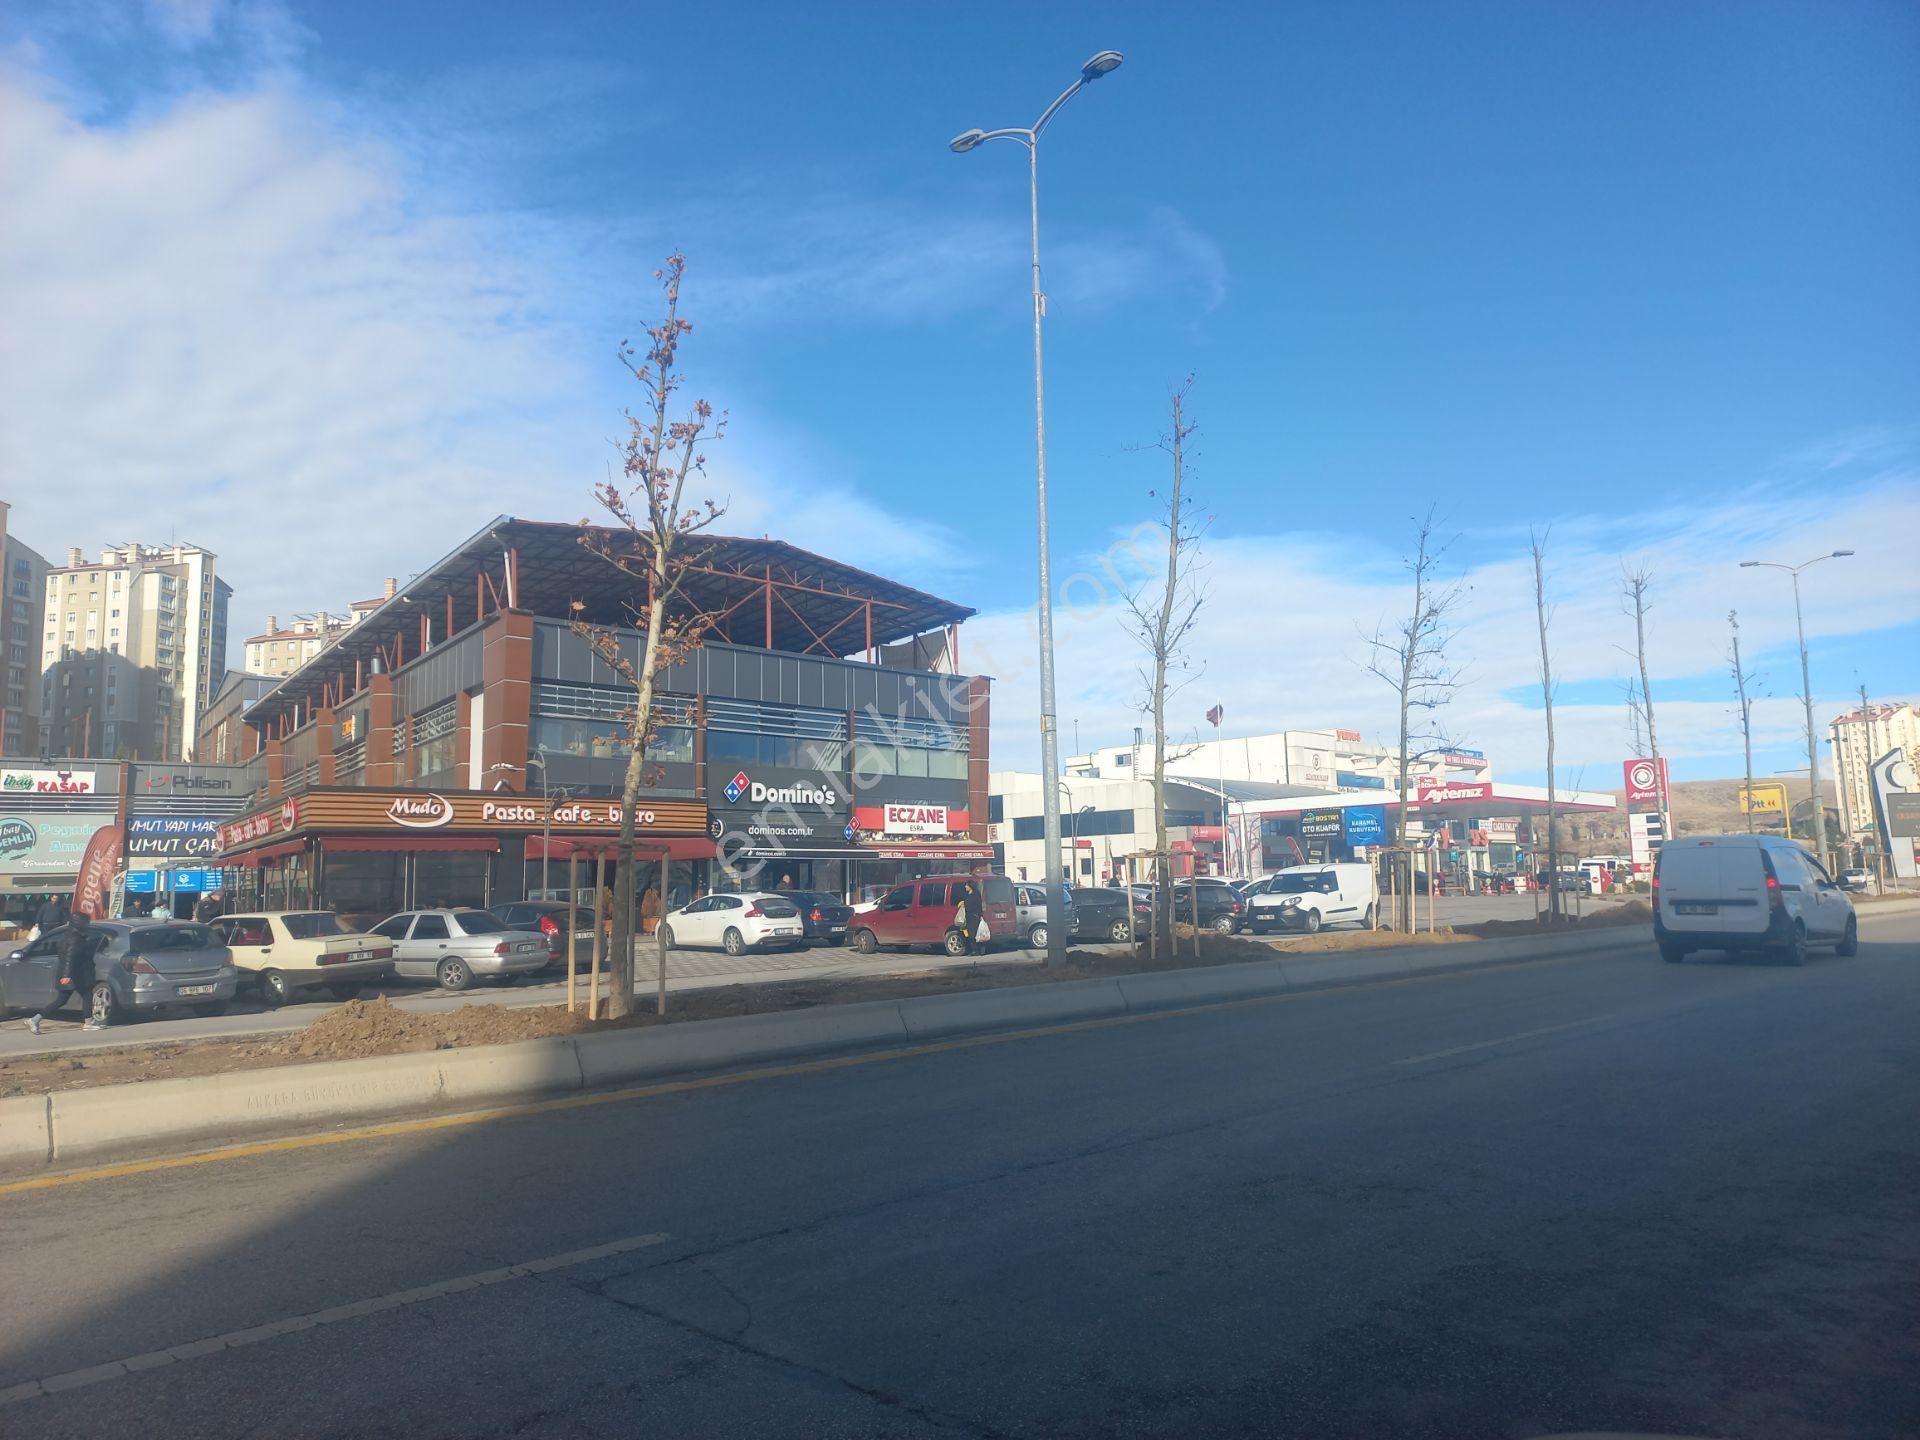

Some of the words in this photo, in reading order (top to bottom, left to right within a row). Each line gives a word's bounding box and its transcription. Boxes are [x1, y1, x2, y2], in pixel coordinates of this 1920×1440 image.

[38, 781, 89, 793] KASAP
[172, 775, 232, 790] Polisan
[751, 782, 836, 805] Domino's
[1424, 787, 1484, 804] Aytemiz
[482, 802, 535, 820] Pasta
[553, 804, 592, 822] cafe
[888, 807, 944, 824] ECZANE
[129, 820, 162, 832] UMUT
[164, 820, 189, 832] YAPI
[748, 826, 814, 836] dominos.com.tr
[909, 824, 924, 832] ESRA
[1302, 825, 1315, 833] OTO
[1316, 822, 1340, 832] KUAFÖR
[129, 839, 180, 852] UMUT
[247, 1086, 297, 1110] ANKARA
